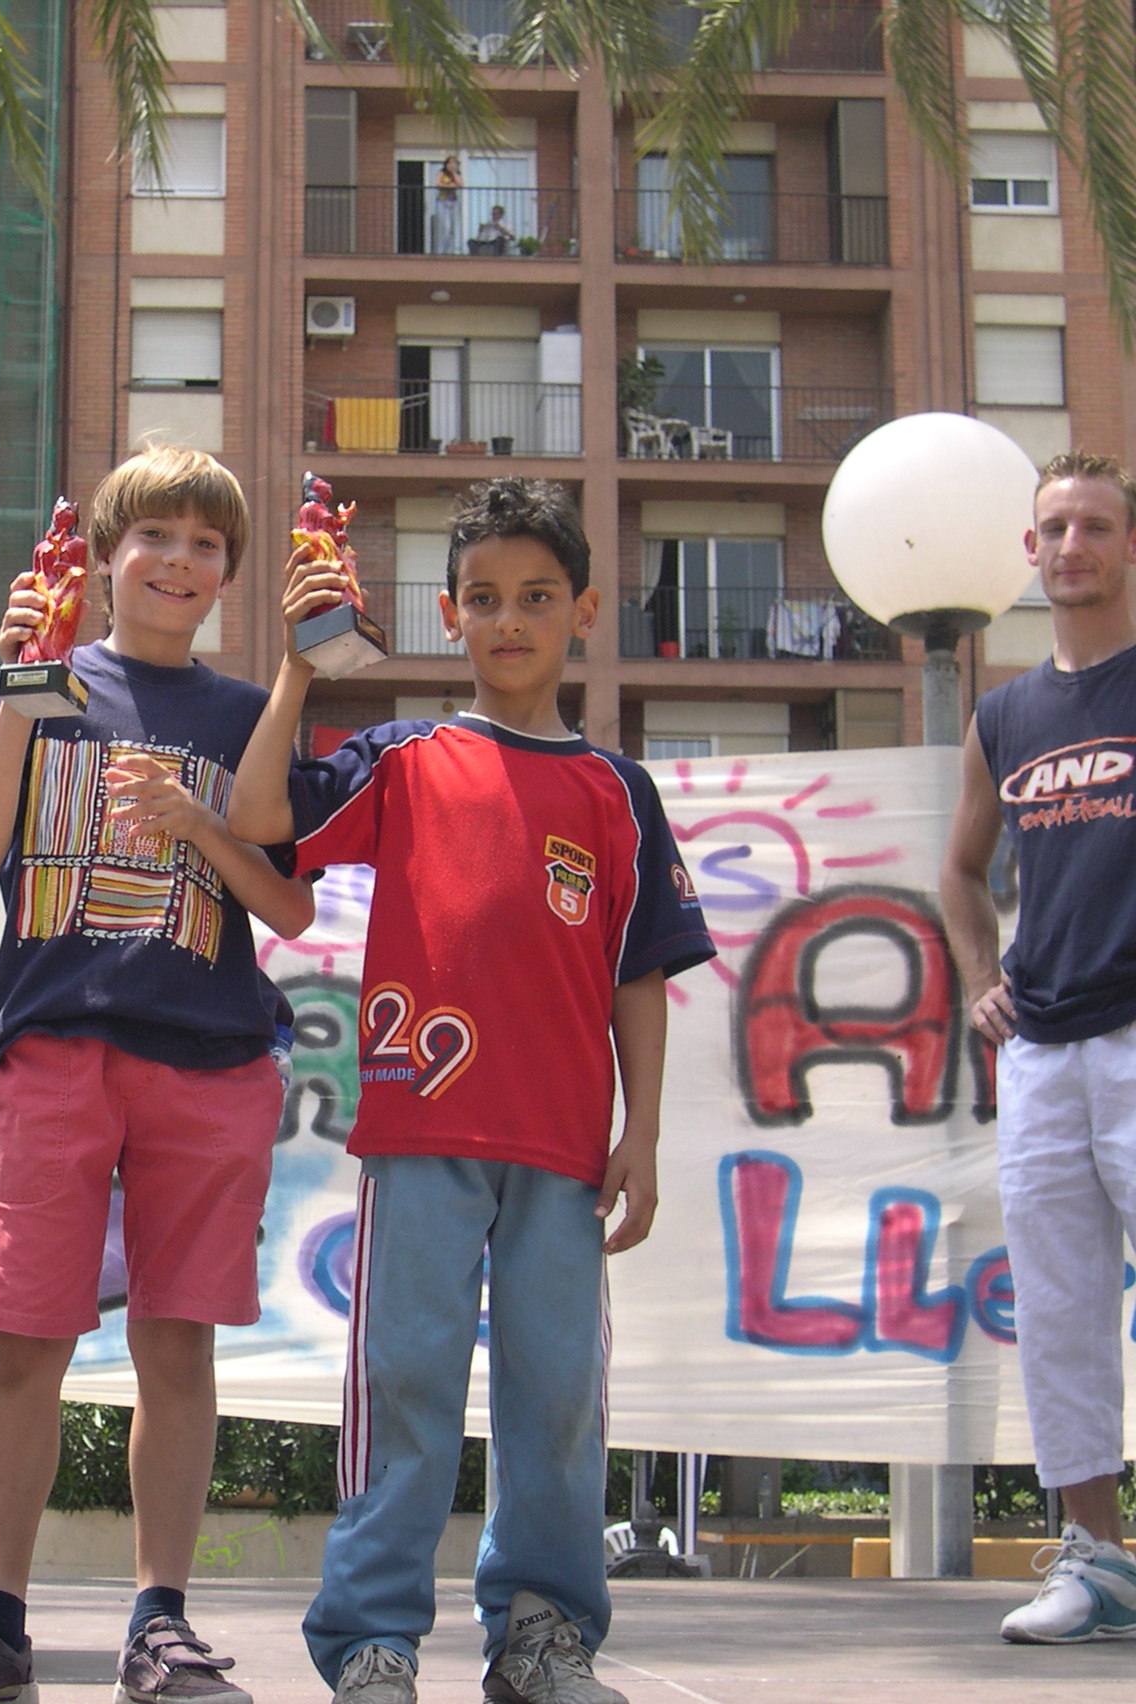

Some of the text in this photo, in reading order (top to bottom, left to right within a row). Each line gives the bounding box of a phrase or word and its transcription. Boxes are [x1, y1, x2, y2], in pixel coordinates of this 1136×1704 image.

[1021, 751, 1134, 799] AND
[551, 841, 594, 869] SPORT
[669, 863, 697, 902] 2
[560, 887, 579, 915] 5
[361, 981, 479, 1101] 29
[375, 1068, 416, 1082] MADE
